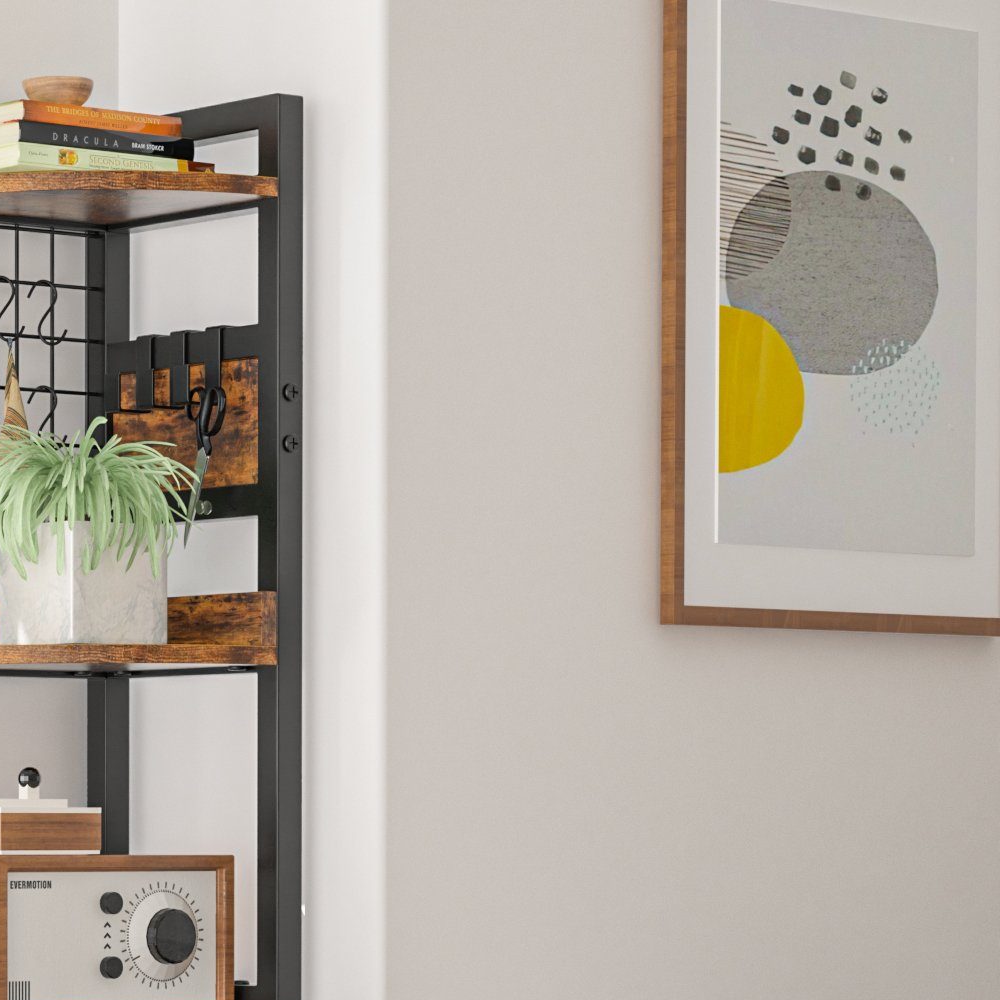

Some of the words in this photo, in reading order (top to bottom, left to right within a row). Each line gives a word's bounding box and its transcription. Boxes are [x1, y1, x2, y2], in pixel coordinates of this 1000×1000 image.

[46, 105, 60, 114] THE
[61, 107, 89, 117] BRIDGES
[90, 110, 99, 118] OF
[101, 111, 132, 121] MADISON
[133, 114, 161, 124] COUNTY
[52, 132, 120, 148] DRACULA
[10, 880, 52, 890] EVERMOTION
